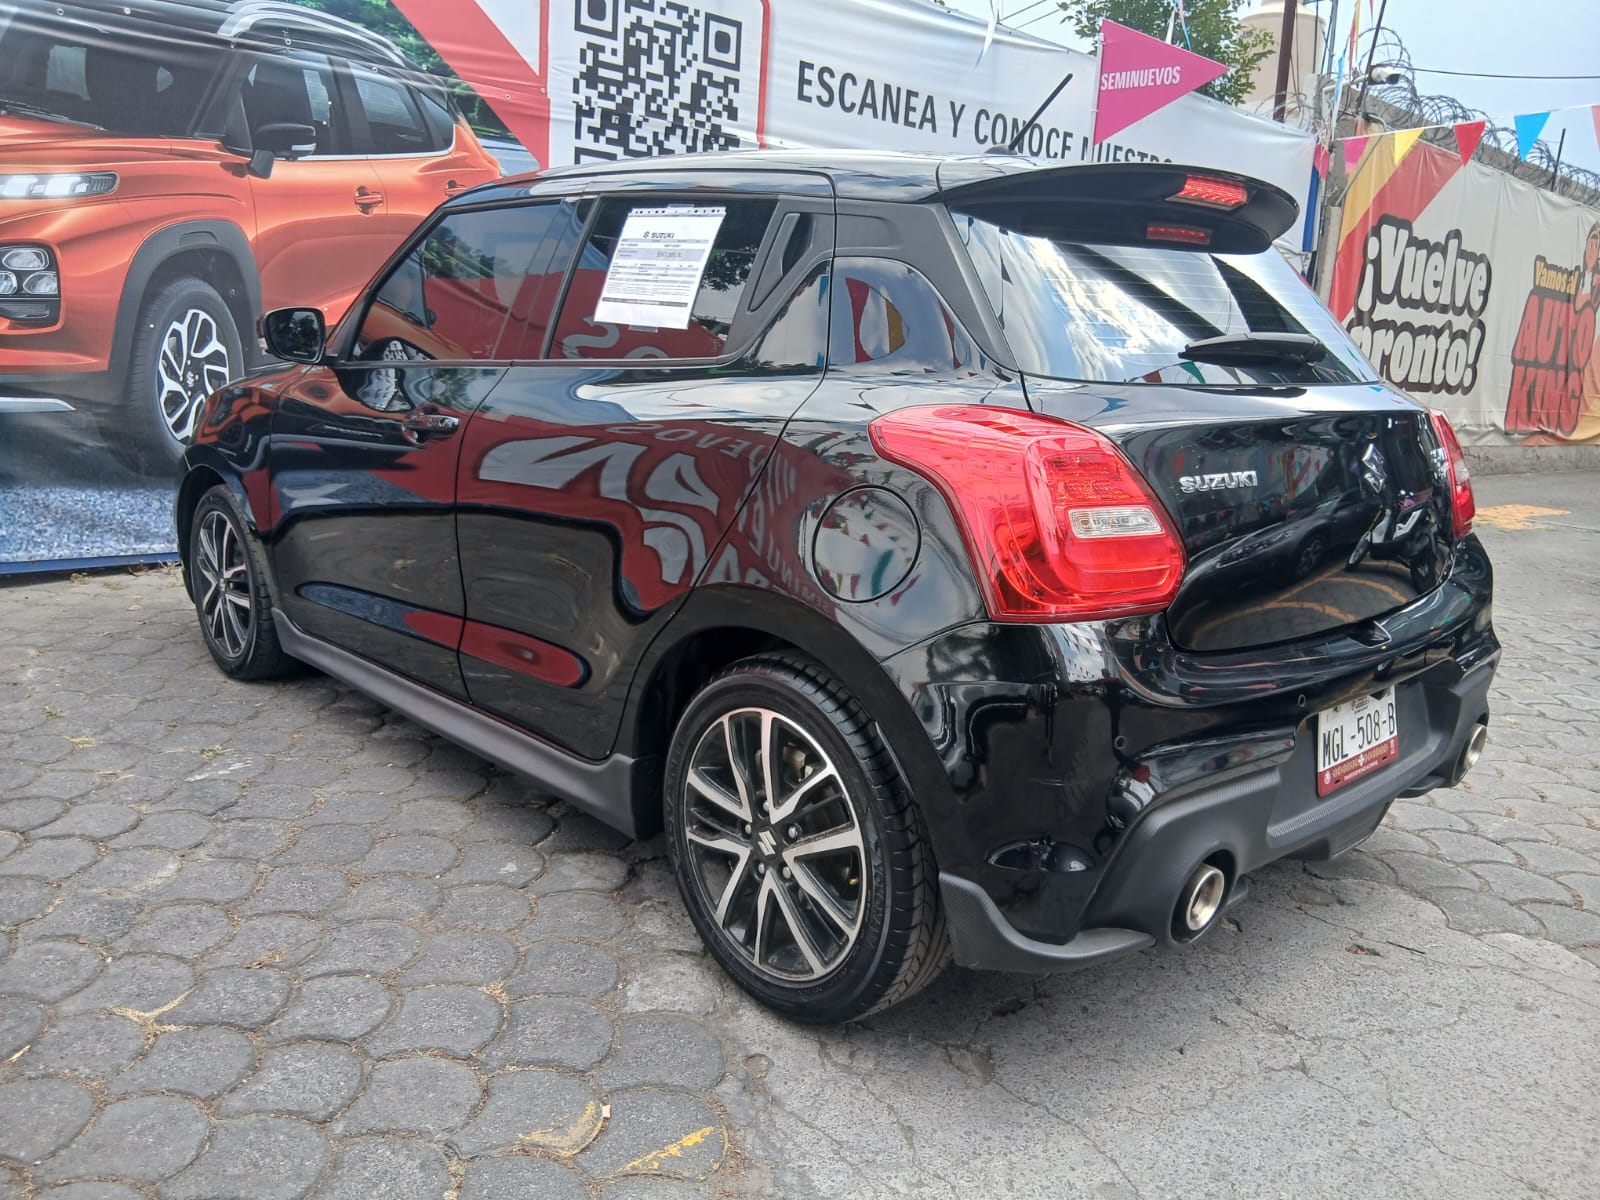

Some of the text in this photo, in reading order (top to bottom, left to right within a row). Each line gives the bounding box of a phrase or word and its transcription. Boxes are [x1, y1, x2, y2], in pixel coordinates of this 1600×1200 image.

[797, 59, 1173, 163] ESCANEA Y CONOCE NUES
[1100, 65, 1181, 91] SEMINUEVOS
[650, 231, 675, 239] SUZUKI
[1356, 217, 1490, 314] ¡Vuelve
[1535, 259, 1567, 293] Vamos
[1512, 294, 1596, 369] AUTO
[1505, 364, 1583, 435] KING
[1179, 469, 1258, 494] SUZUKI
[1322, 701, 1396, 768] MGL-508-B
